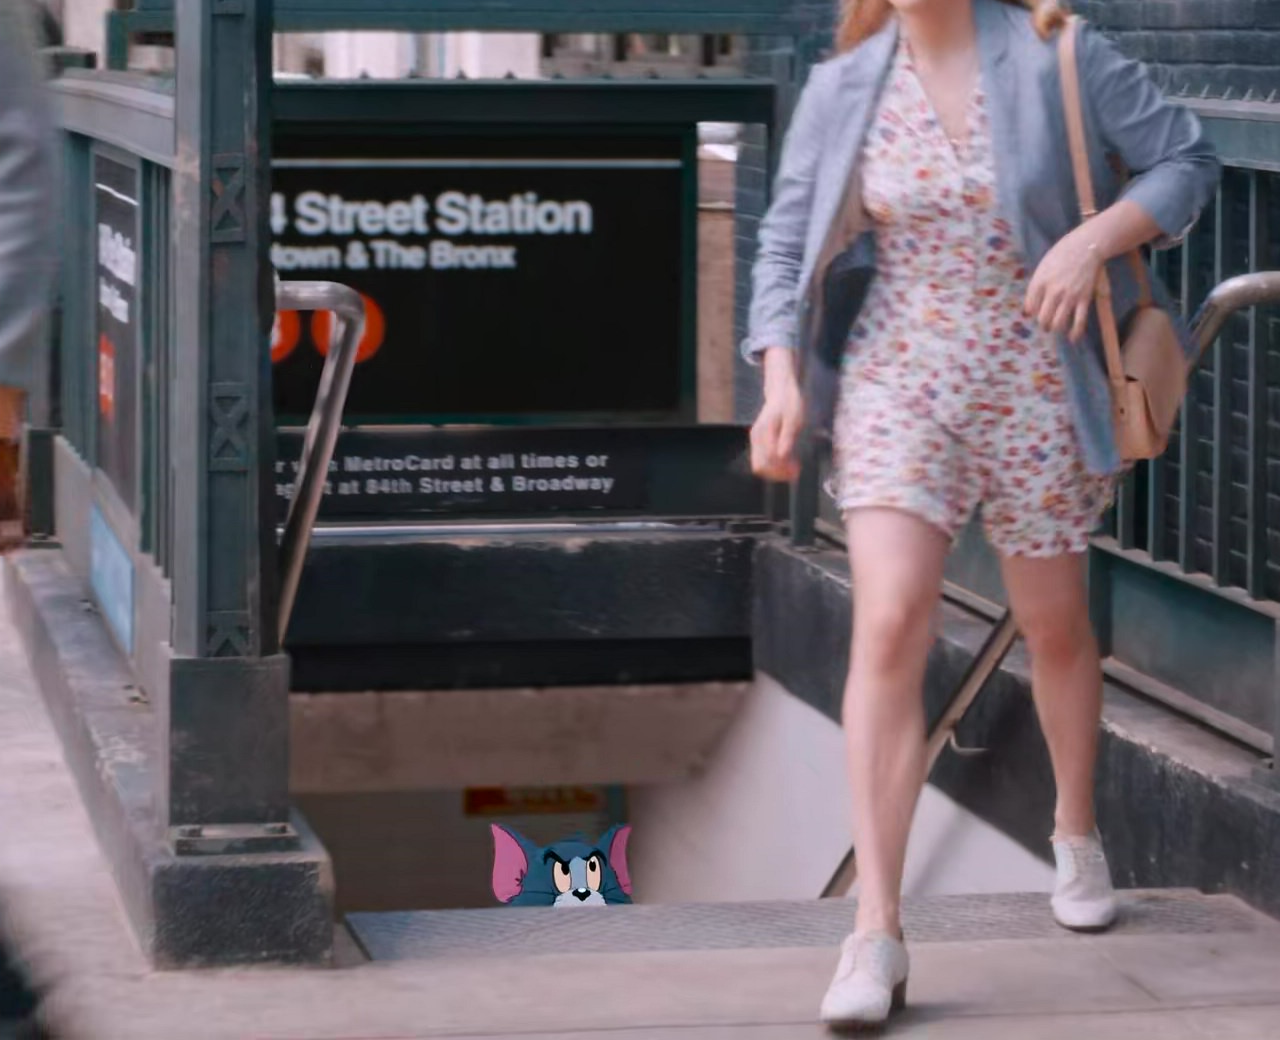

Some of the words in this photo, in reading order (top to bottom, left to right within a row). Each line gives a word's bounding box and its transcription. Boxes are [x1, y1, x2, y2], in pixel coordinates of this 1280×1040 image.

[293, 190, 430, 235] Street
[434, 190, 593, 235] Station
[270, 242, 341, 270] town
[345, 240, 369, 270] &
[370, 239, 427, 269] The
[428, 240, 518, 270] Bronx
[343, 454, 455, 472] MetroCard
[460, 455, 483, 471] at
[487, 453, 515, 470] all
[521, 453, 580, 469] times
[585, 455, 609, 468] or
[338, 480, 361, 496] at
[366, 478, 413, 494] 84th
[419, 477, 484, 494] Street
[490, 476, 505, 493] &
[512, 474, 615, 494] Broadway
